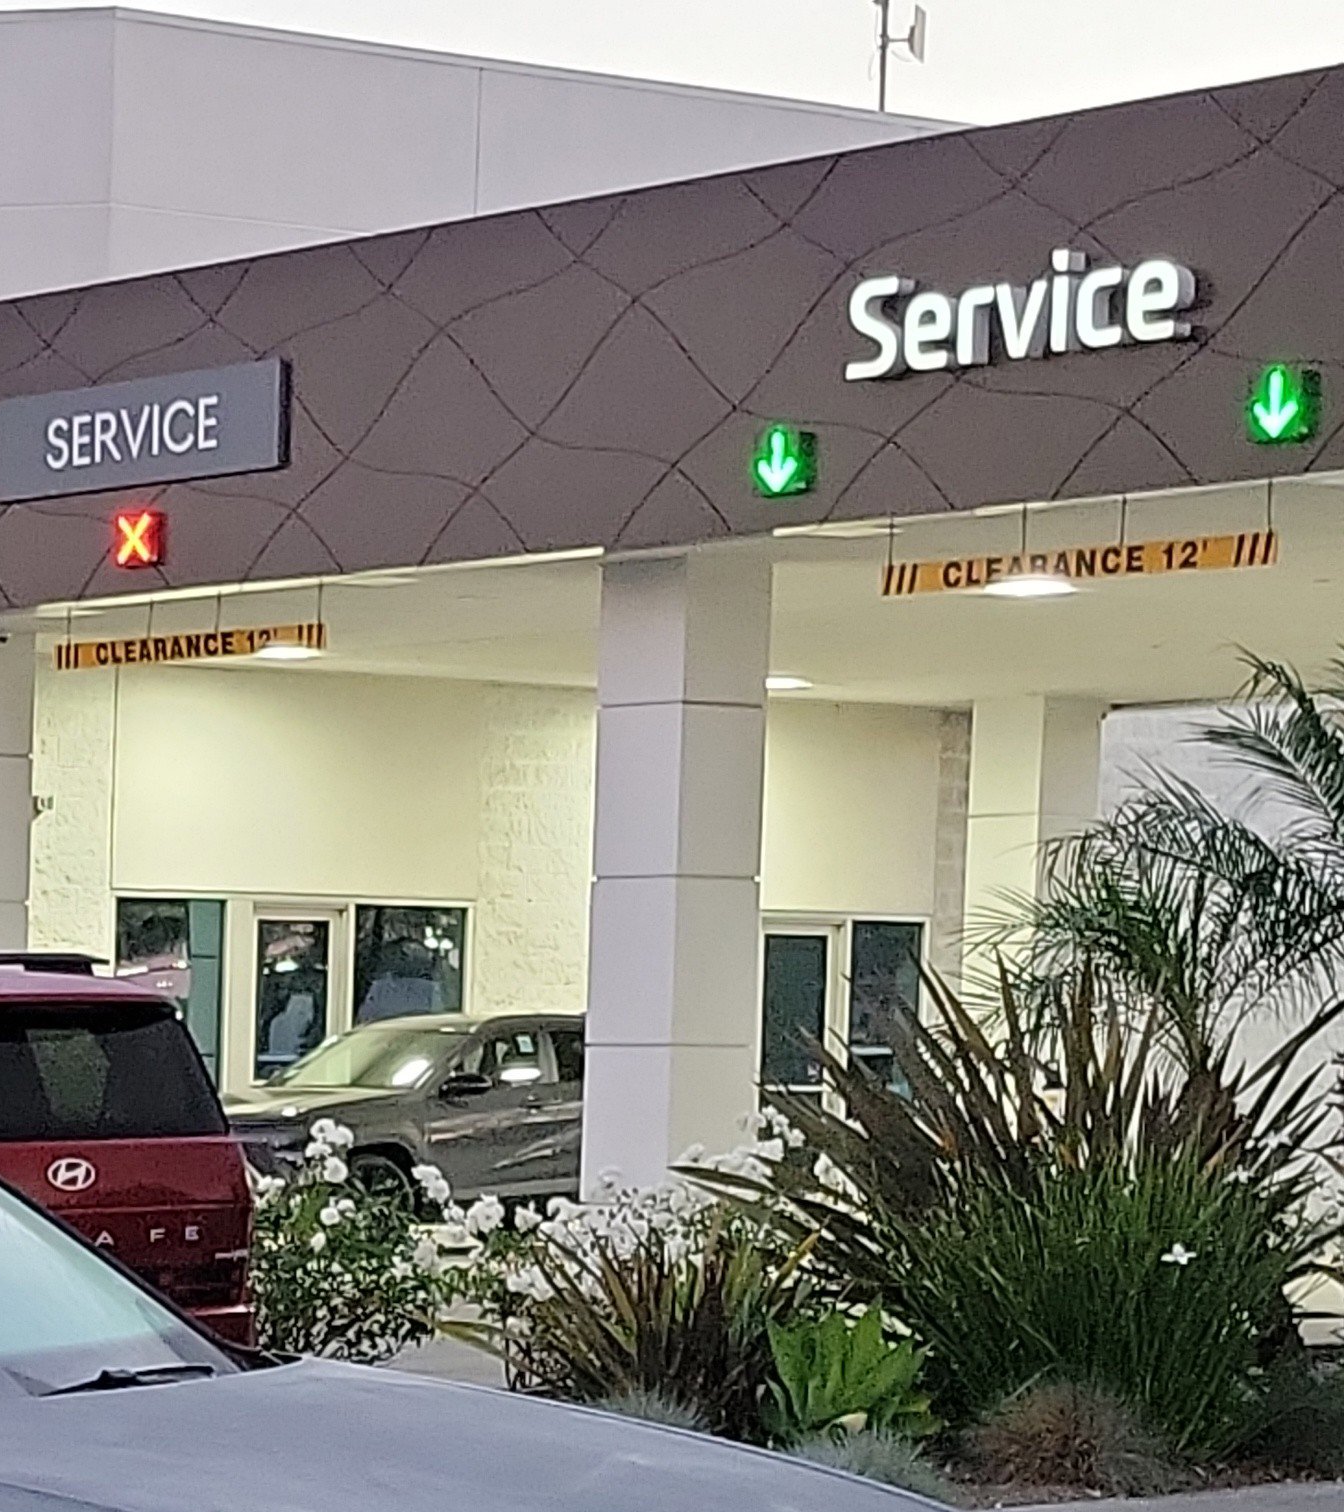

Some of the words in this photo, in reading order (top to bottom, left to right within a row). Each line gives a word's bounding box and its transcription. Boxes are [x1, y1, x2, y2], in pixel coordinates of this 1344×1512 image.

[845, 249, 1191, 381] Service
[45, 395, 219, 470] SERVICE
[942, 545, 1144, 588] CLEARANCE
[95, 632, 234, 665] CLEARANCE
